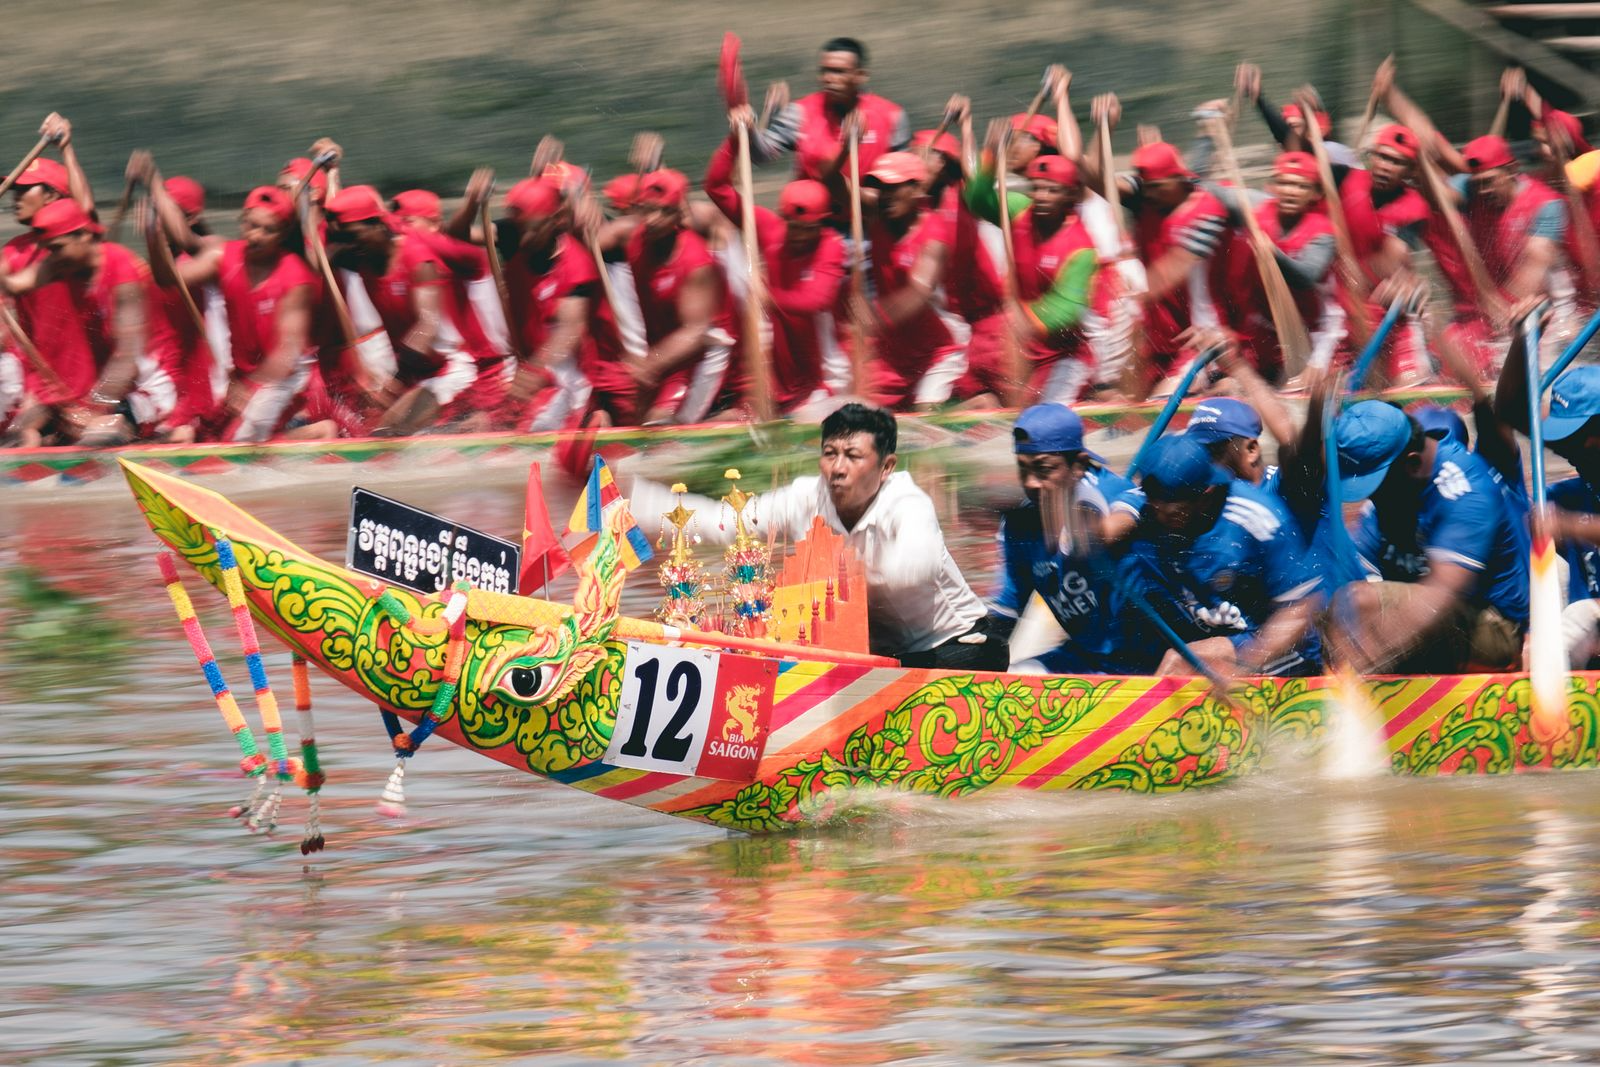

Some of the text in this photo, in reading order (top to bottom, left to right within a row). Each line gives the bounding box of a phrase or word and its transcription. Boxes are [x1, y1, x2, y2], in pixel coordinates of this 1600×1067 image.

[620, 657, 702, 763] 12
[729, 733, 744, 744] BIA
[708, 741, 759, 760] SAIGON
